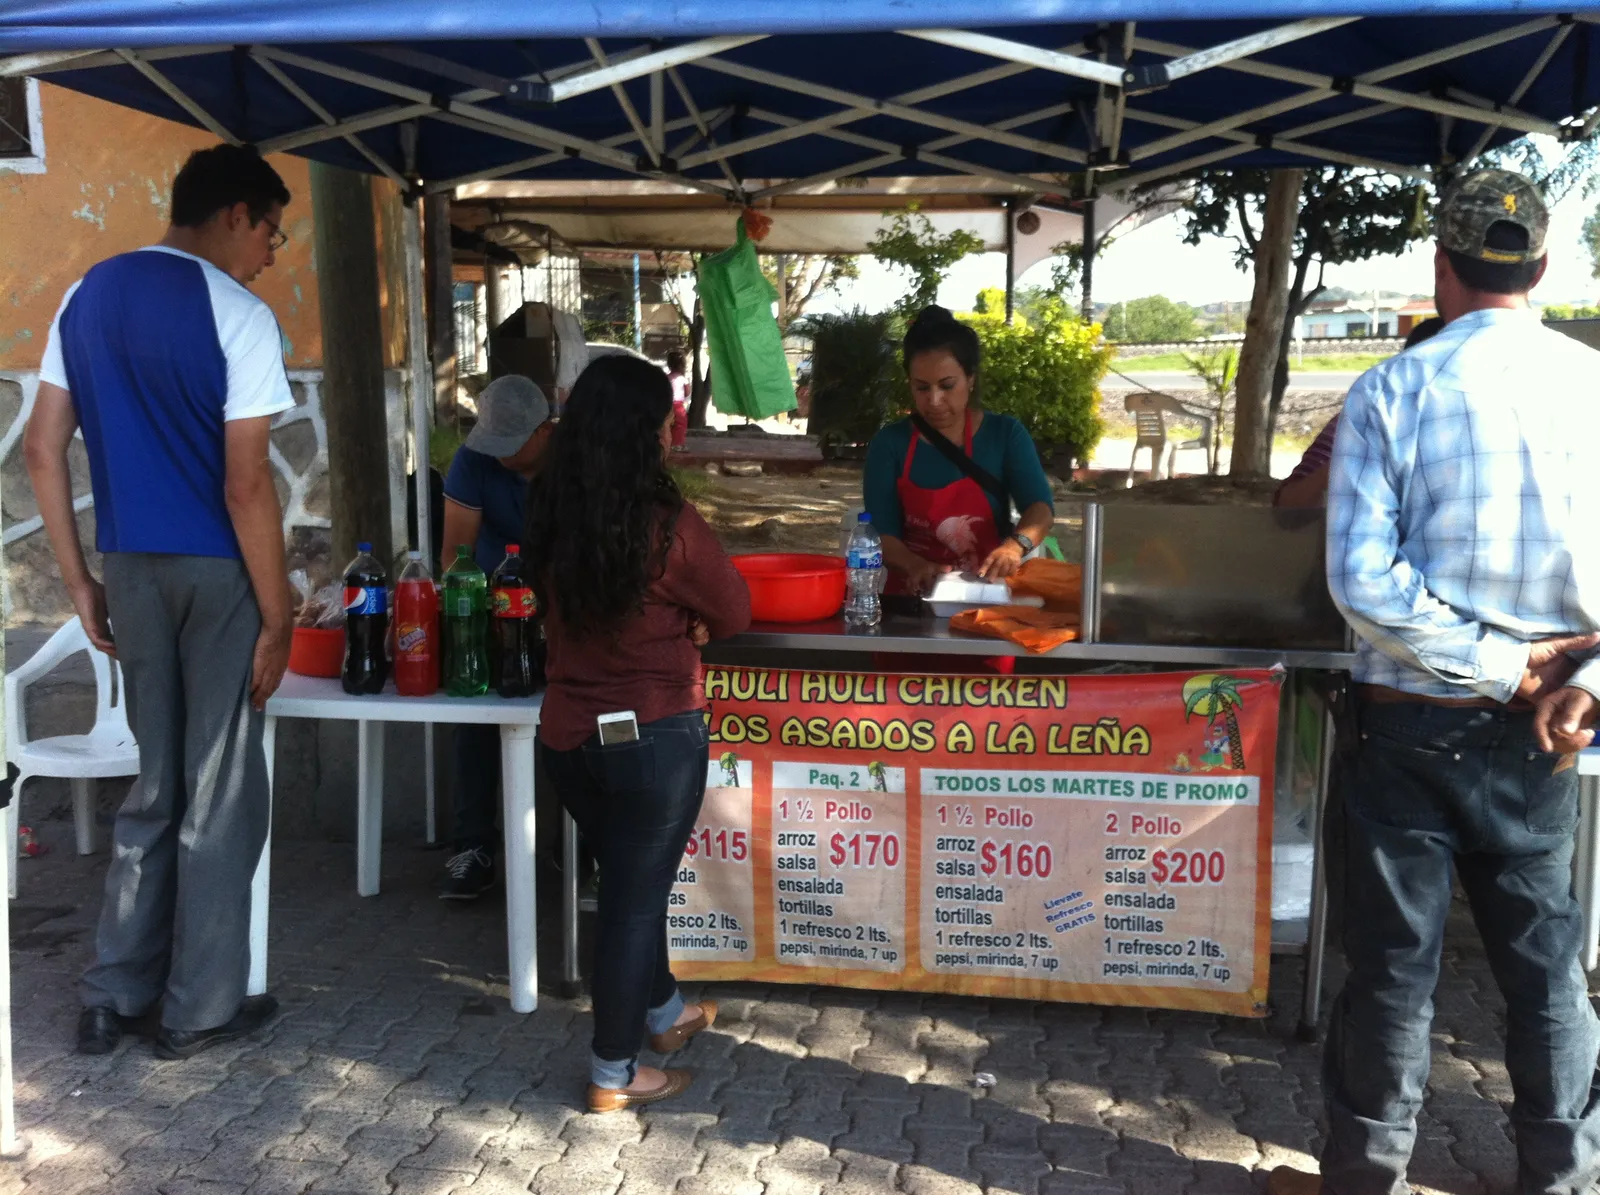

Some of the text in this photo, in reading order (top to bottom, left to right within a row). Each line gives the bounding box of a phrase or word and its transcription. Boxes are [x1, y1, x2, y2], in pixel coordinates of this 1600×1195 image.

[704, 669, 1067, 709] HULI HULI CHICKEN
[703, 712, 1151, 756] LOS ASADOS A LA LEÑA
[809, 769, 860, 789] Paq. 2
[935, 775, 1249, 801] TODOS LOS MARTES DE PROMO
[779, 800, 872, 821] 1 ½ Pollo
[937, 806, 1033, 828] 1 ½ Pollo
[1106, 813, 1182, 836] 2 Pollo
[685, 827, 748, 861] $115
[777, 833, 816, 847] arroz
[829, 831, 899, 869] $170
[936, 837, 976, 852] arroz
[777, 854, 816, 870] salsa
[980, 841, 1052, 879] $160
[1105, 847, 1146, 861] arroz
[936, 859, 975, 876] salsa
[1104, 868, 1146, 885] salsa
[1150, 849, 1225, 887] $200
[778, 878, 844, 895] ensalada
[935, 884, 1004, 903] ensalada
[779, 899, 833, 917] tortillas
[1104, 892, 1176, 910] ensalada
[667, 913, 742, 931] esco 2 lts.
[935, 907, 993, 926] tortillas
[1045, 901, 1094, 923] Refresco
[780, 920, 891, 943] 1 refresco 2 lts.
[1055, 913, 1096, 933] GRATIS
[1104, 914, 1164, 933] tortillas
[671, 934, 748, 952] mirinda, 7 up
[936, 932, 1053, 949] 1 refresco 2 lts.
[1105, 940, 1226, 958] 1 refresco 2 lts.
[780, 942, 898, 964] pepsi, mirinda, 7 up
[935, 952, 1059, 972] pepsi, mirinda, 7 up
[1103, 960, 1231, 984] pepsi, mirinda, 7 up
